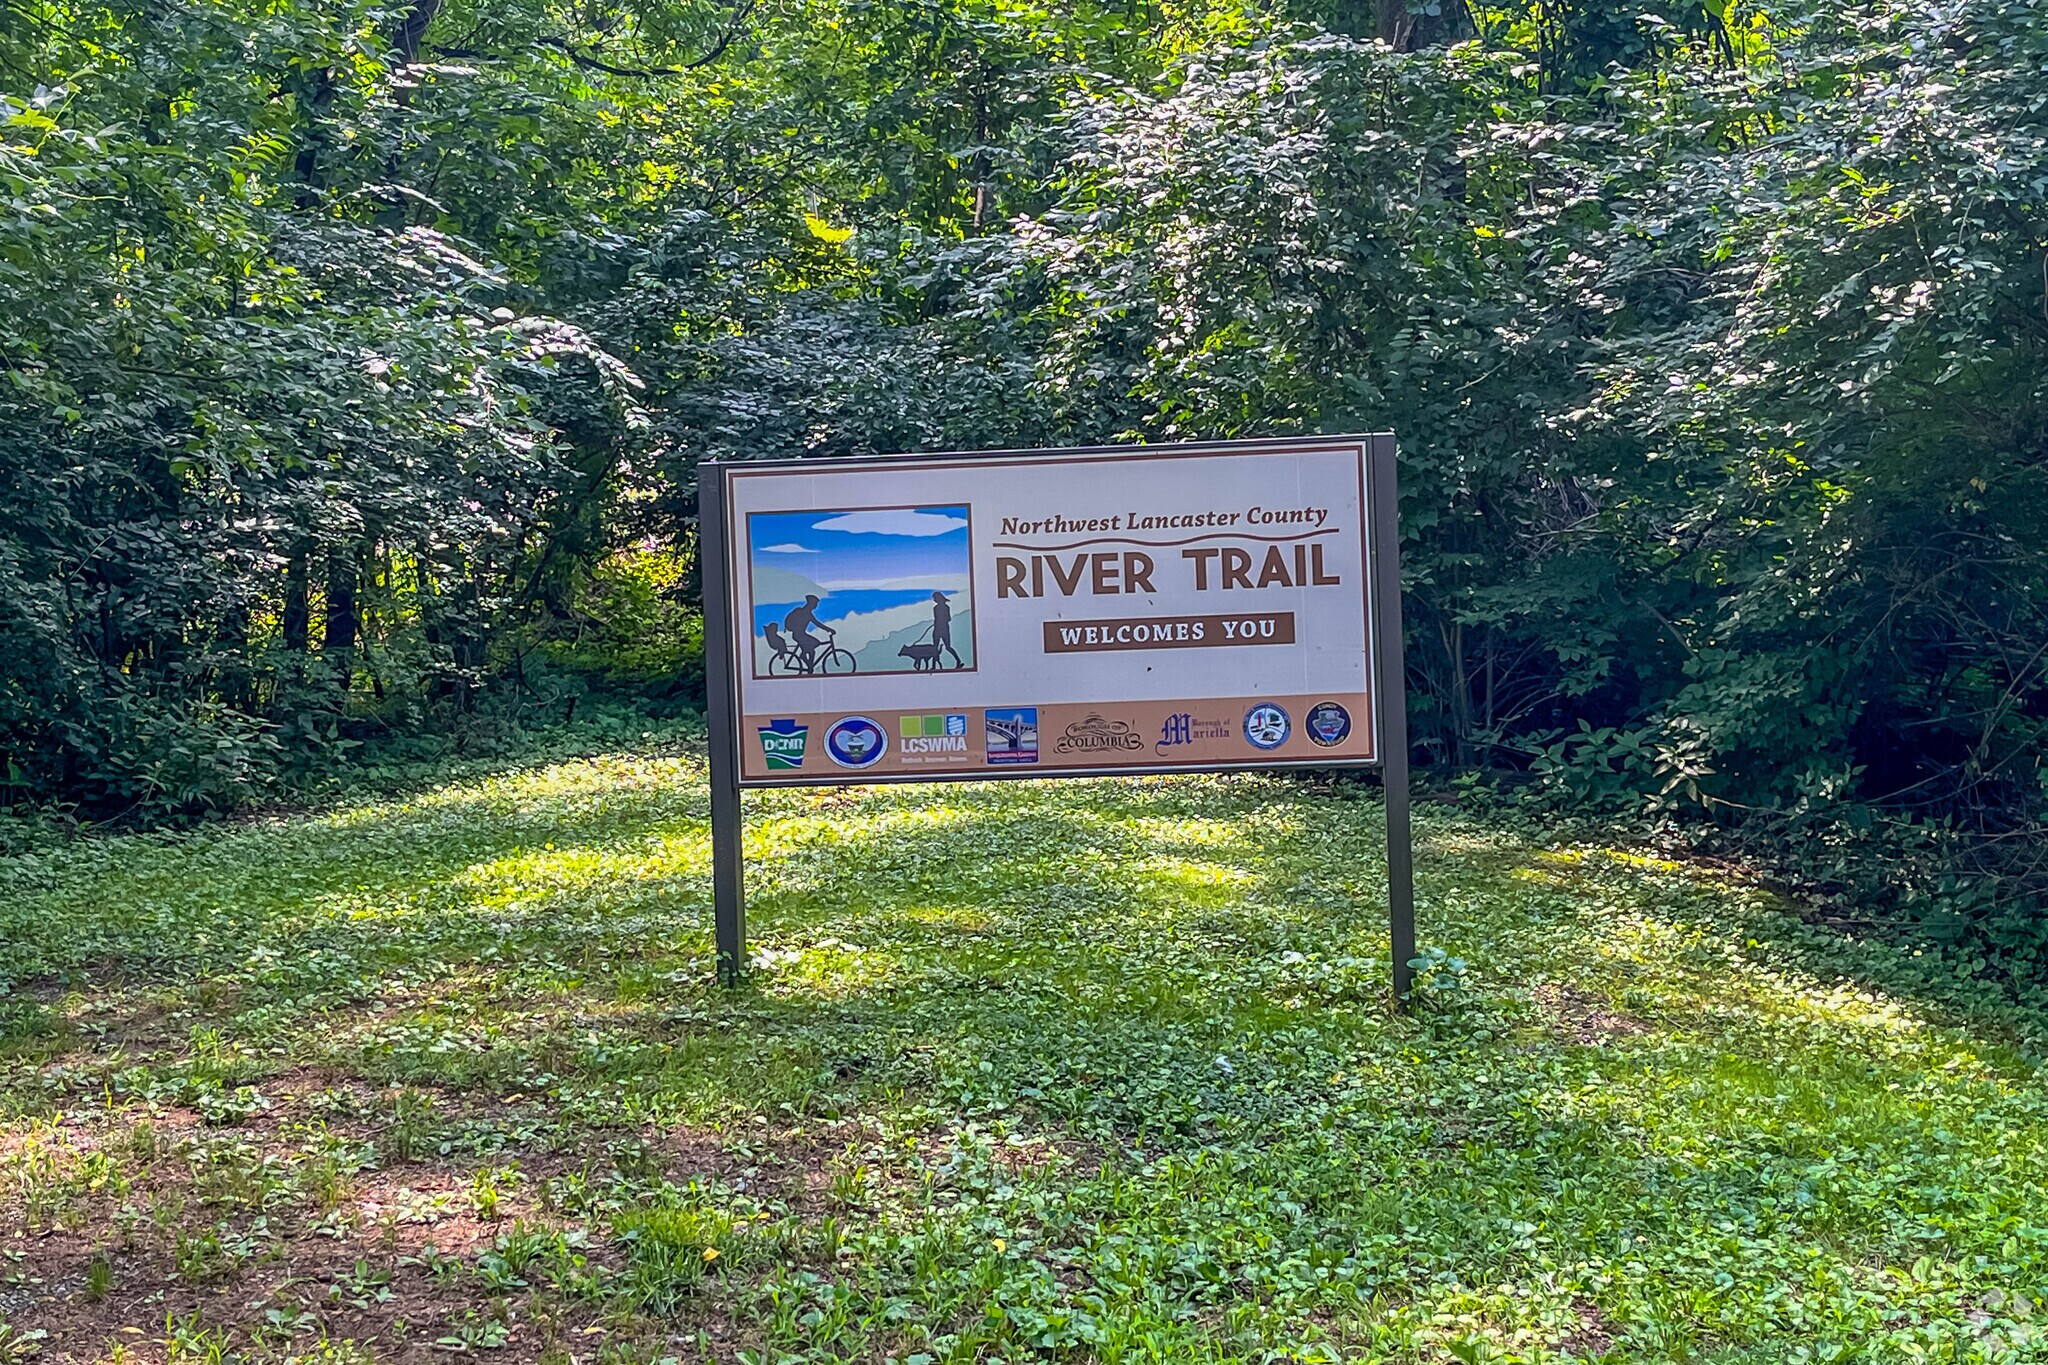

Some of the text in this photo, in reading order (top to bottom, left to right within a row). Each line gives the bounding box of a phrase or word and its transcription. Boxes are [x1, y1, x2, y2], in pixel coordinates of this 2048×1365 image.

[1000, 506, 1328, 535] Northwest Lancaster County
[996, 543, 1340, 598] RIVER TRAIL
[1059, 619, 1276, 645] WELCOMES YOU
[764, 738, 804, 751] DCNR
[901, 736, 968, 753] LCSWMA
[1067, 736, 1131, 748] COLUMBIA
